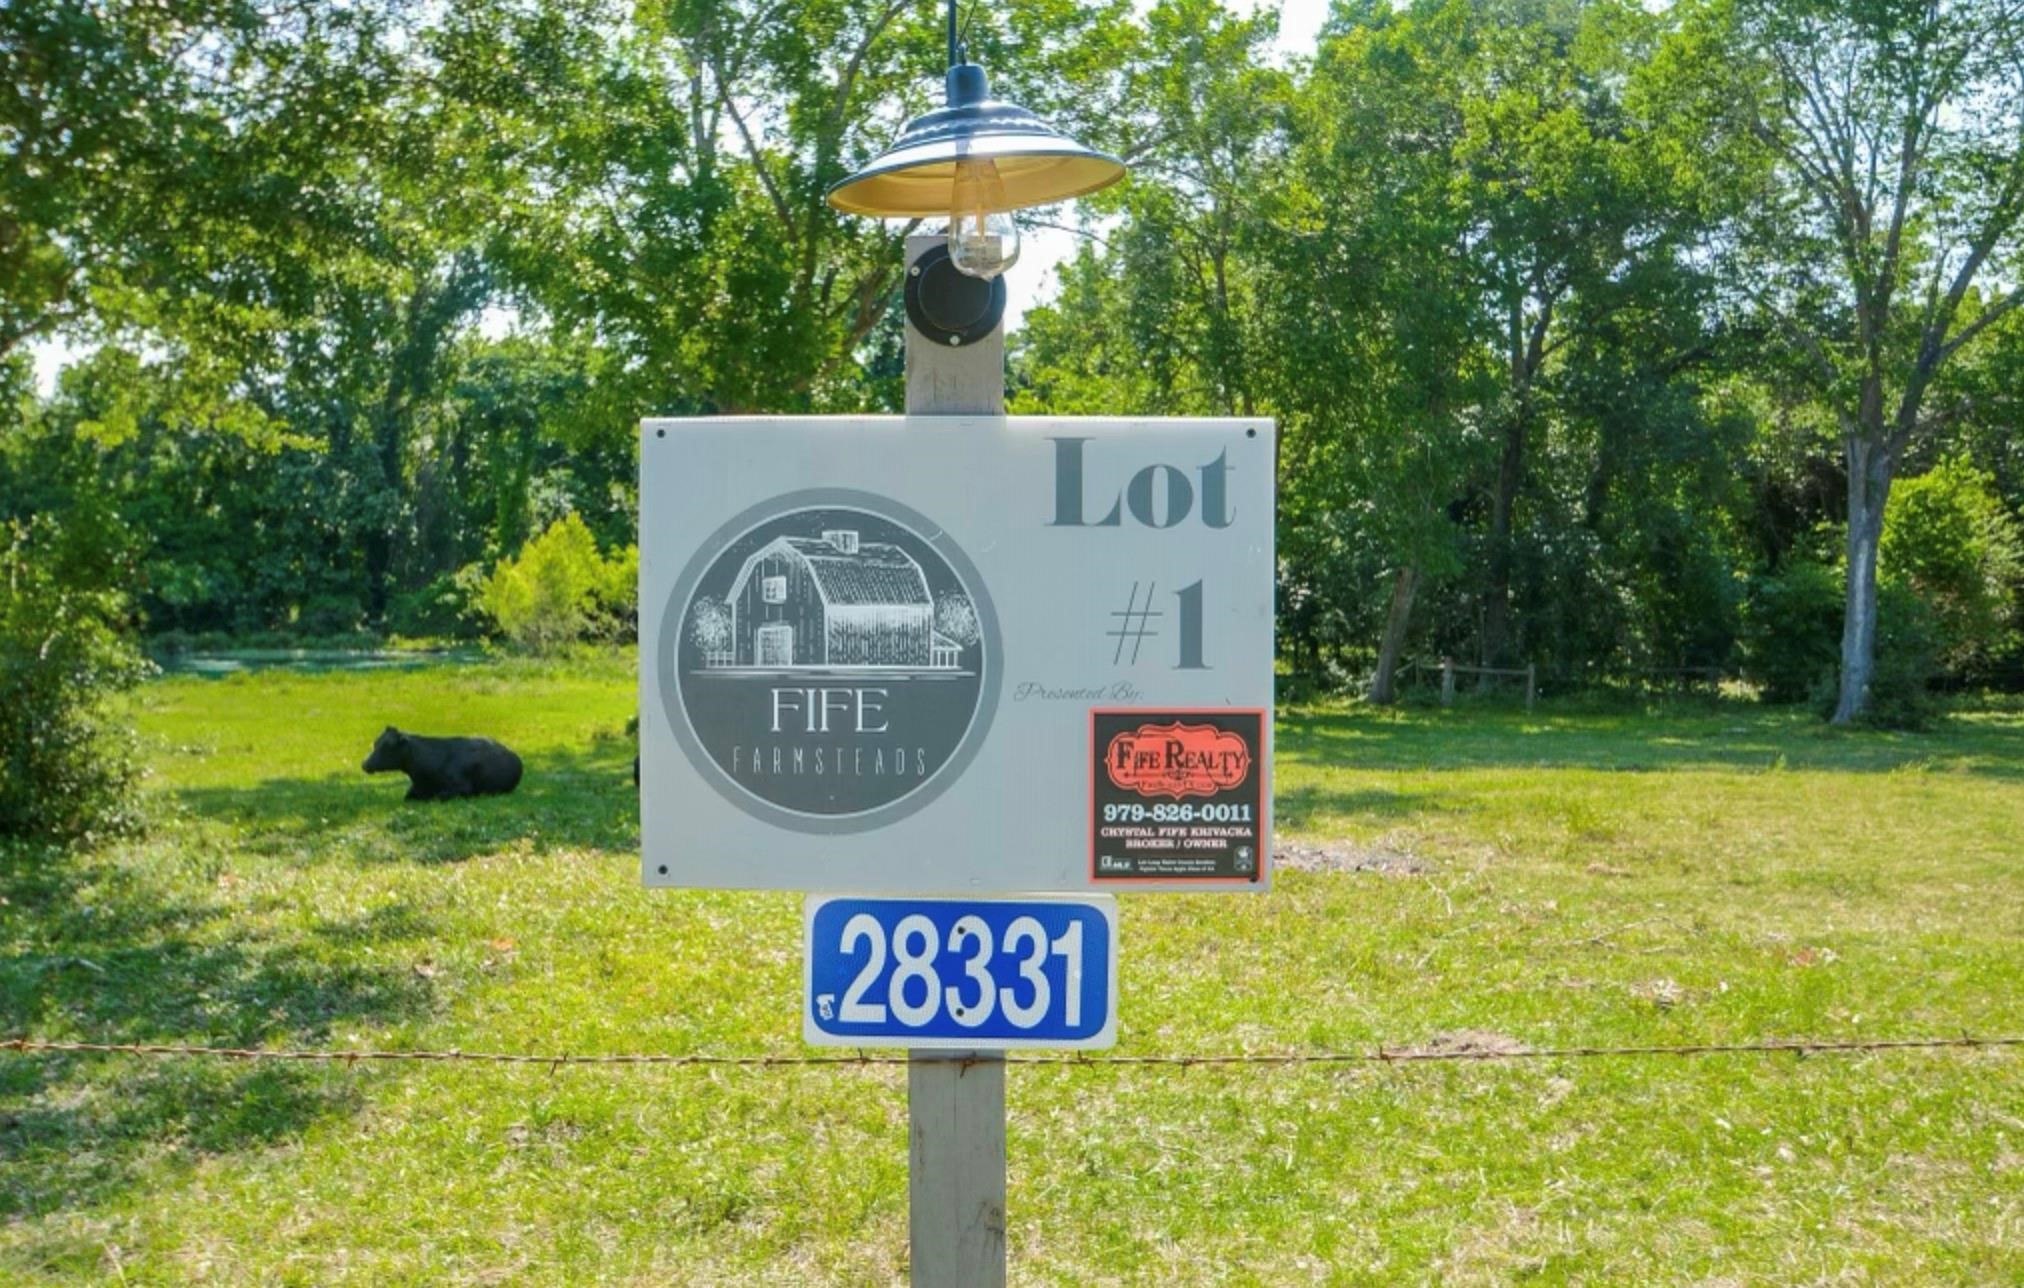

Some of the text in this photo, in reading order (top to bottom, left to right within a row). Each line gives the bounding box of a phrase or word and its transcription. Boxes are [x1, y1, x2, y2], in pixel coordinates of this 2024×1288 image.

[1043, 436, 1237, 529] Lot
[1106, 578, 1213, 671] #1
[1013, 681, 1107, 703] Presented
[771, 688, 889, 733] FIFE
[733, 746, 926, 775] FARMSTEADS
[1103, 803, 1251, 822] 979-826-0011
[1126, 838, 1175, 849] BROKER
[1183, 838, 1227, 849] OWNER
[1158, 826, 1188, 837] FIFE
[838, 913, 1083, 1029] 28331
